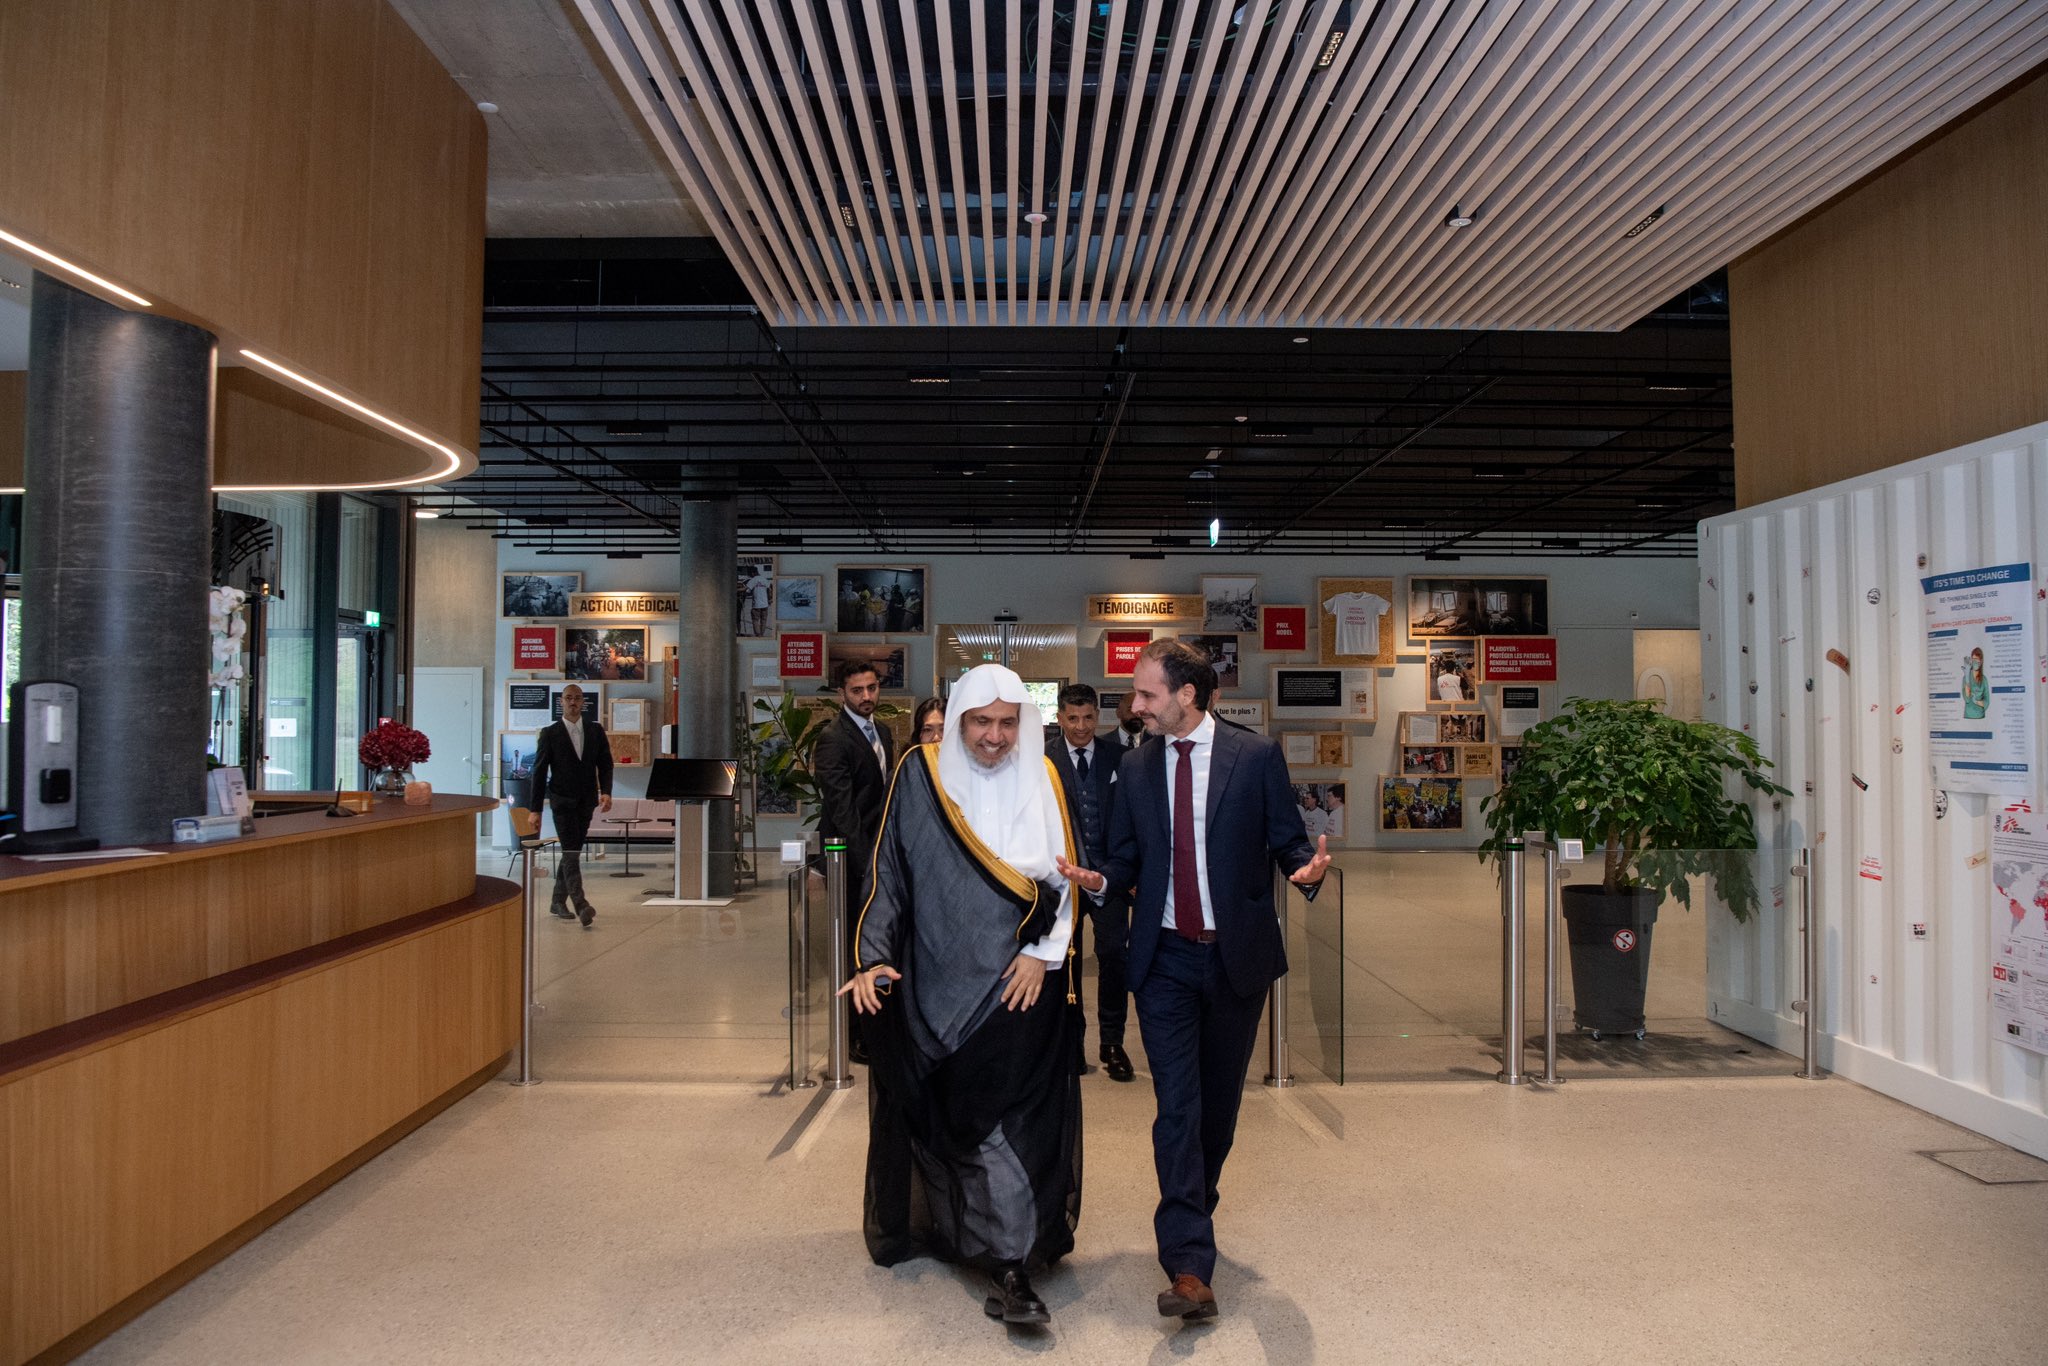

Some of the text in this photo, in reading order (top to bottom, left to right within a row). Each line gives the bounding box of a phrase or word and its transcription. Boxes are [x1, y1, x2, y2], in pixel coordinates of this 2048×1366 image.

[1949, 576, 1965, 586] TIME
[1966, 574, 1976, 583] TO
[1976, 570, 2010, 582] CHANGE
[580, 596, 680, 612] ACTION MÉDICAL
[1097, 598, 1174, 614] TÉMOIGNAGE
[1951, 603, 1970, 611] MEDICAL
[1987, 615, 2013, 623] LEBANON
[1230, 707, 1237, 715] le
[1237, 707, 1251, 716] plus
[1252, 707, 1257, 715] ?
